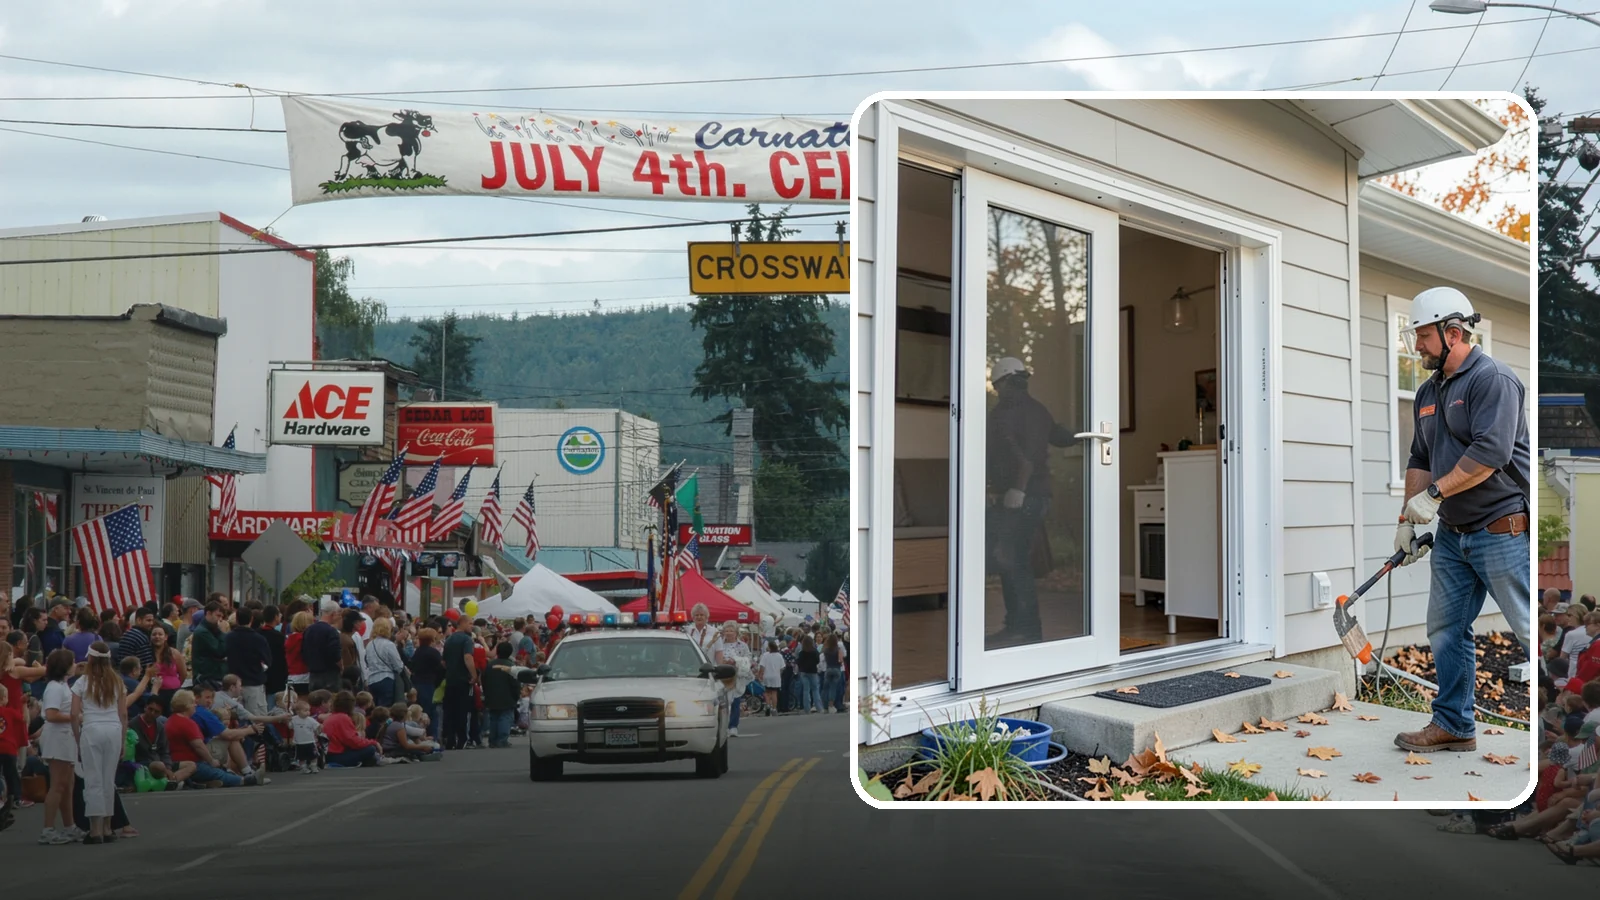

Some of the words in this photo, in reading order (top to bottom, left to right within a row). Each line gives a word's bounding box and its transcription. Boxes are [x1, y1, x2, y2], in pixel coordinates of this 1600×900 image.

[695, 121, 850, 150] Carnat
[481, 141, 605, 192] JULY
[632, 150, 747, 198] 4th.
[697, 254, 850, 280] CROSSWA
[282, 380, 374, 420] ACE
[405, 409, 452, 422] CEDAR
[283, 421, 371, 436] Hardware
[353, 467, 387, 479] Simpl
[95, 485, 124, 494] Vincent
[126, 486, 135, 494] de
[137, 486, 155, 495] Paul
[688, 526, 741, 535] CRNATION
[699, 535, 730, 543] GLASS
